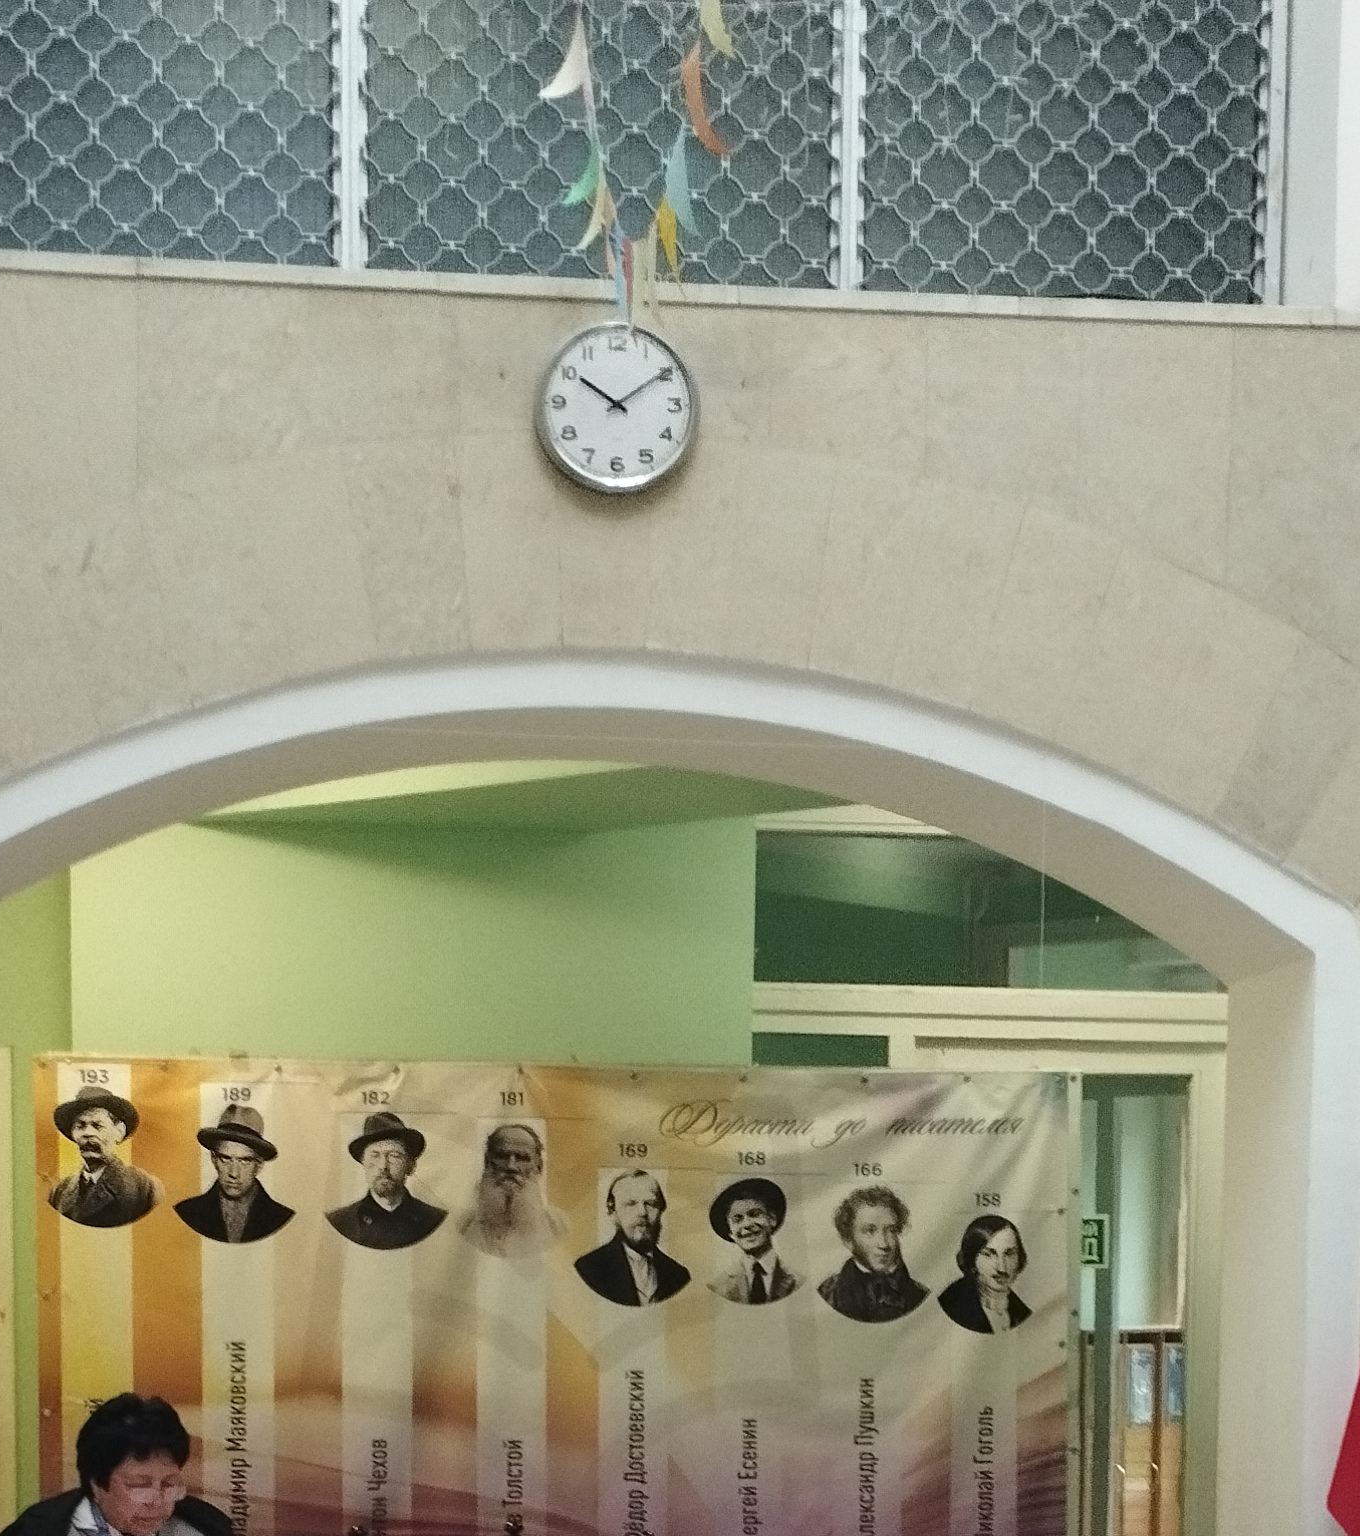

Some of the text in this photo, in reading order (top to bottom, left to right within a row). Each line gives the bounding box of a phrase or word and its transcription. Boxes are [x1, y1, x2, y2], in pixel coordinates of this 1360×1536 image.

[608, 336, 627, 351] 12
[582, 345, 594, 361] 11
[561, 366, 577, 380] 10
[551, 394, 567, 410] 9
[667, 397, 682, 413] 3
[561, 425, 578, 441] 8
[658, 426, 673, 442] 4
[581, 448, 596, 464] 7
[610, 456, 625, 472] 6
[638, 449, 654, 464] 5
[79, 1069, 110, 1084] 193
[221, 1087, 251, 1101] 189
[361, 1091, 390, 1105] 182
[500, 1091, 524, 1106] 181
[886, 1115, 1024, 1136] писателя
[618, 1143, 648, 1158] 169
[737, 1151, 766, 1166] 168
[853, 1162, 883, 1177] 166
[974, 1192, 1001, 1207] 158
[224, 1340, 248, 1452] Маяковский
[853, 1377, 880, 1447] Пушкин
[622, 1369, 648, 1485] Достоевский
[972, 1405, 995, 1465] Гоголь
[737, 1417, 759, 1481] Есенин
[366, 1438, 389, 1492] Чехов
[501, 1439, 524, 1508] Толстой
